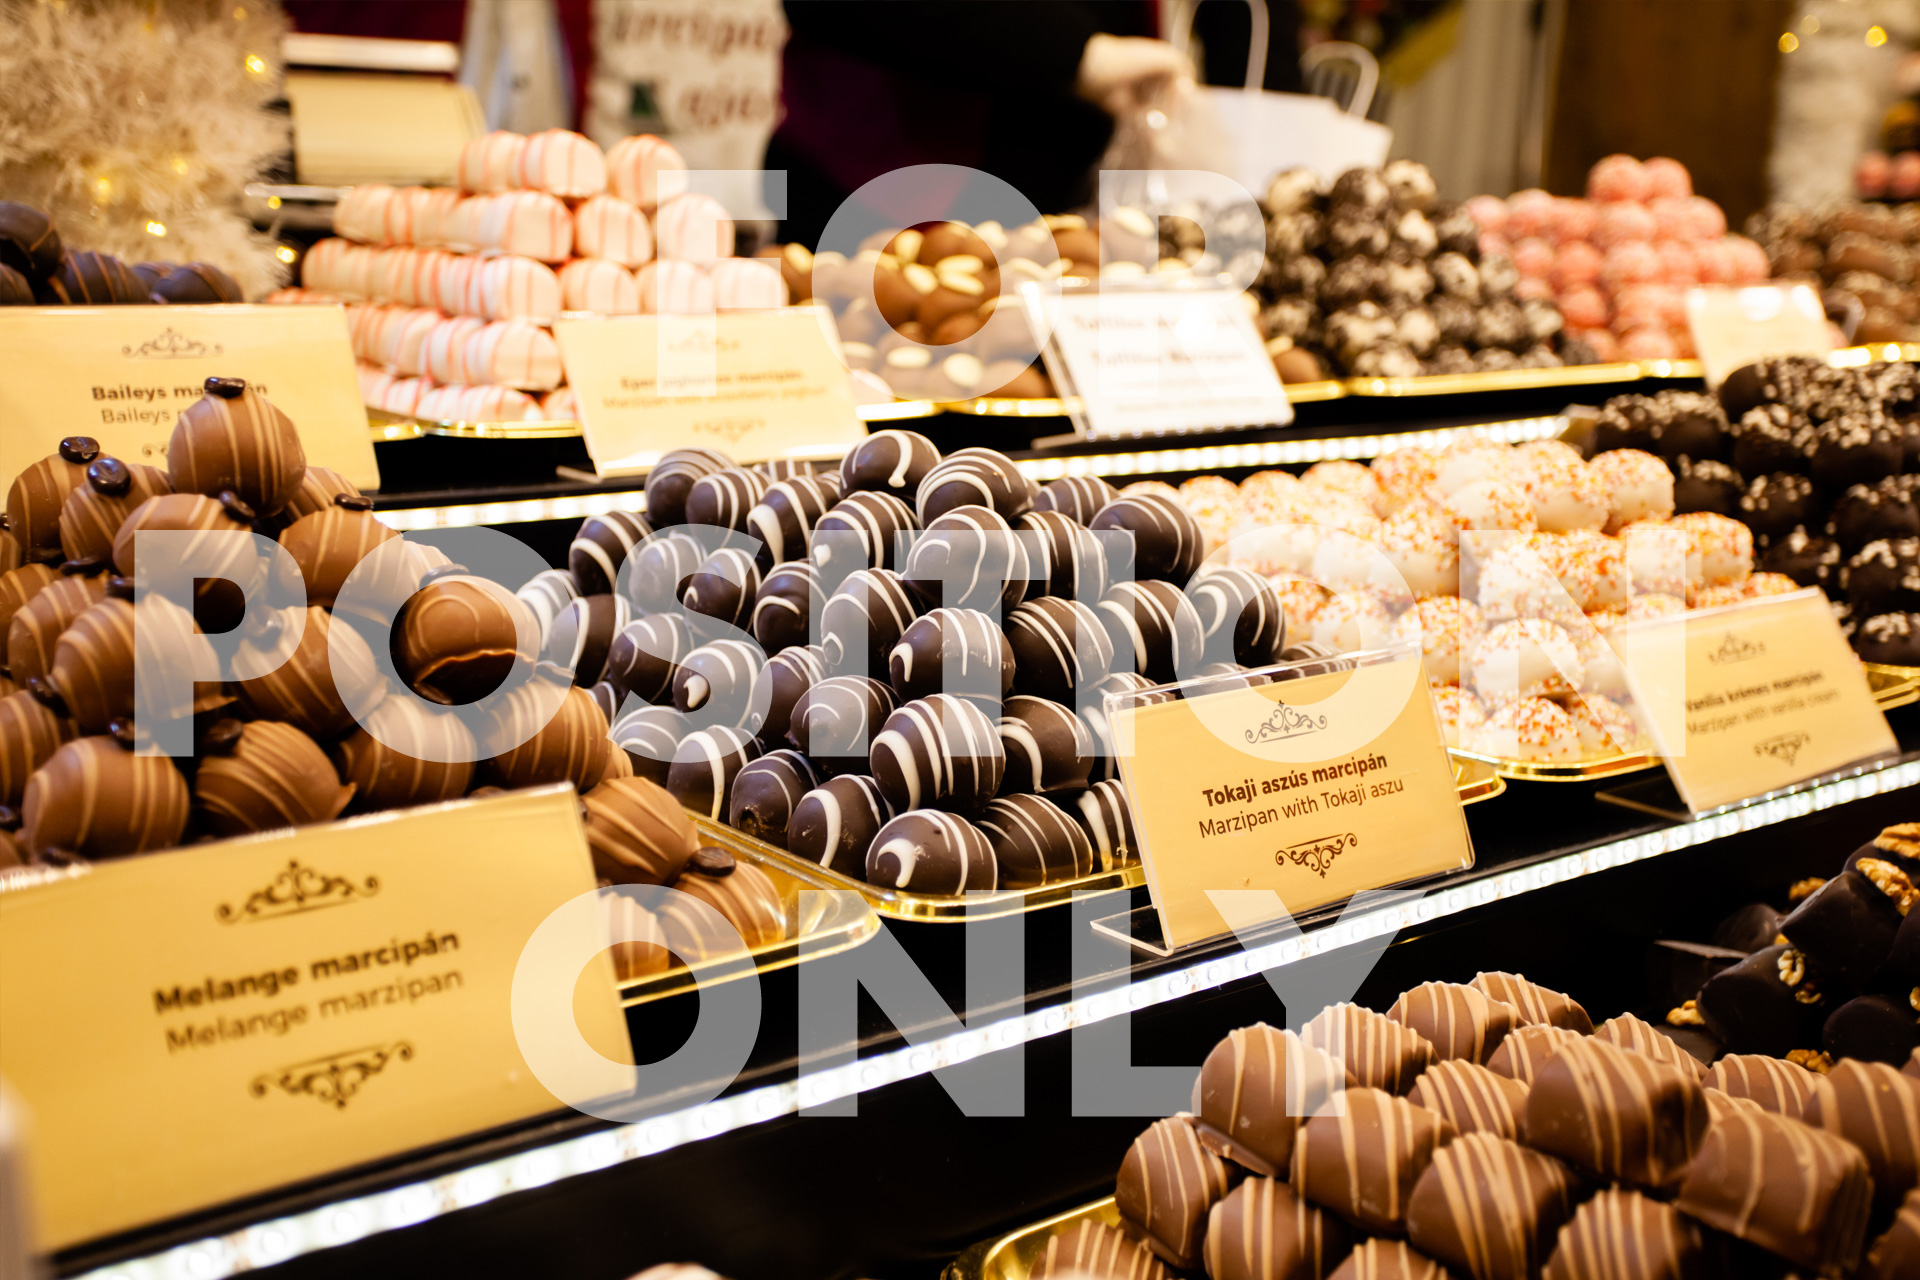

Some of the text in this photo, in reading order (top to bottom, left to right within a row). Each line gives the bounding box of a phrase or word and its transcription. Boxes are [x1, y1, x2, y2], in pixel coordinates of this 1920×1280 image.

[92, 383, 269, 403] Baileys maán
[101, 407, 171, 426] Baileys
[1199, 777, 1405, 839] Marzipan with Tokaji aszu
[1203, 753, 1388, 808] Tokaji aszús marcipán
[153, 930, 461, 1015] Melange marcipán
[165, 970, 464, 1054] Melange marzipan
